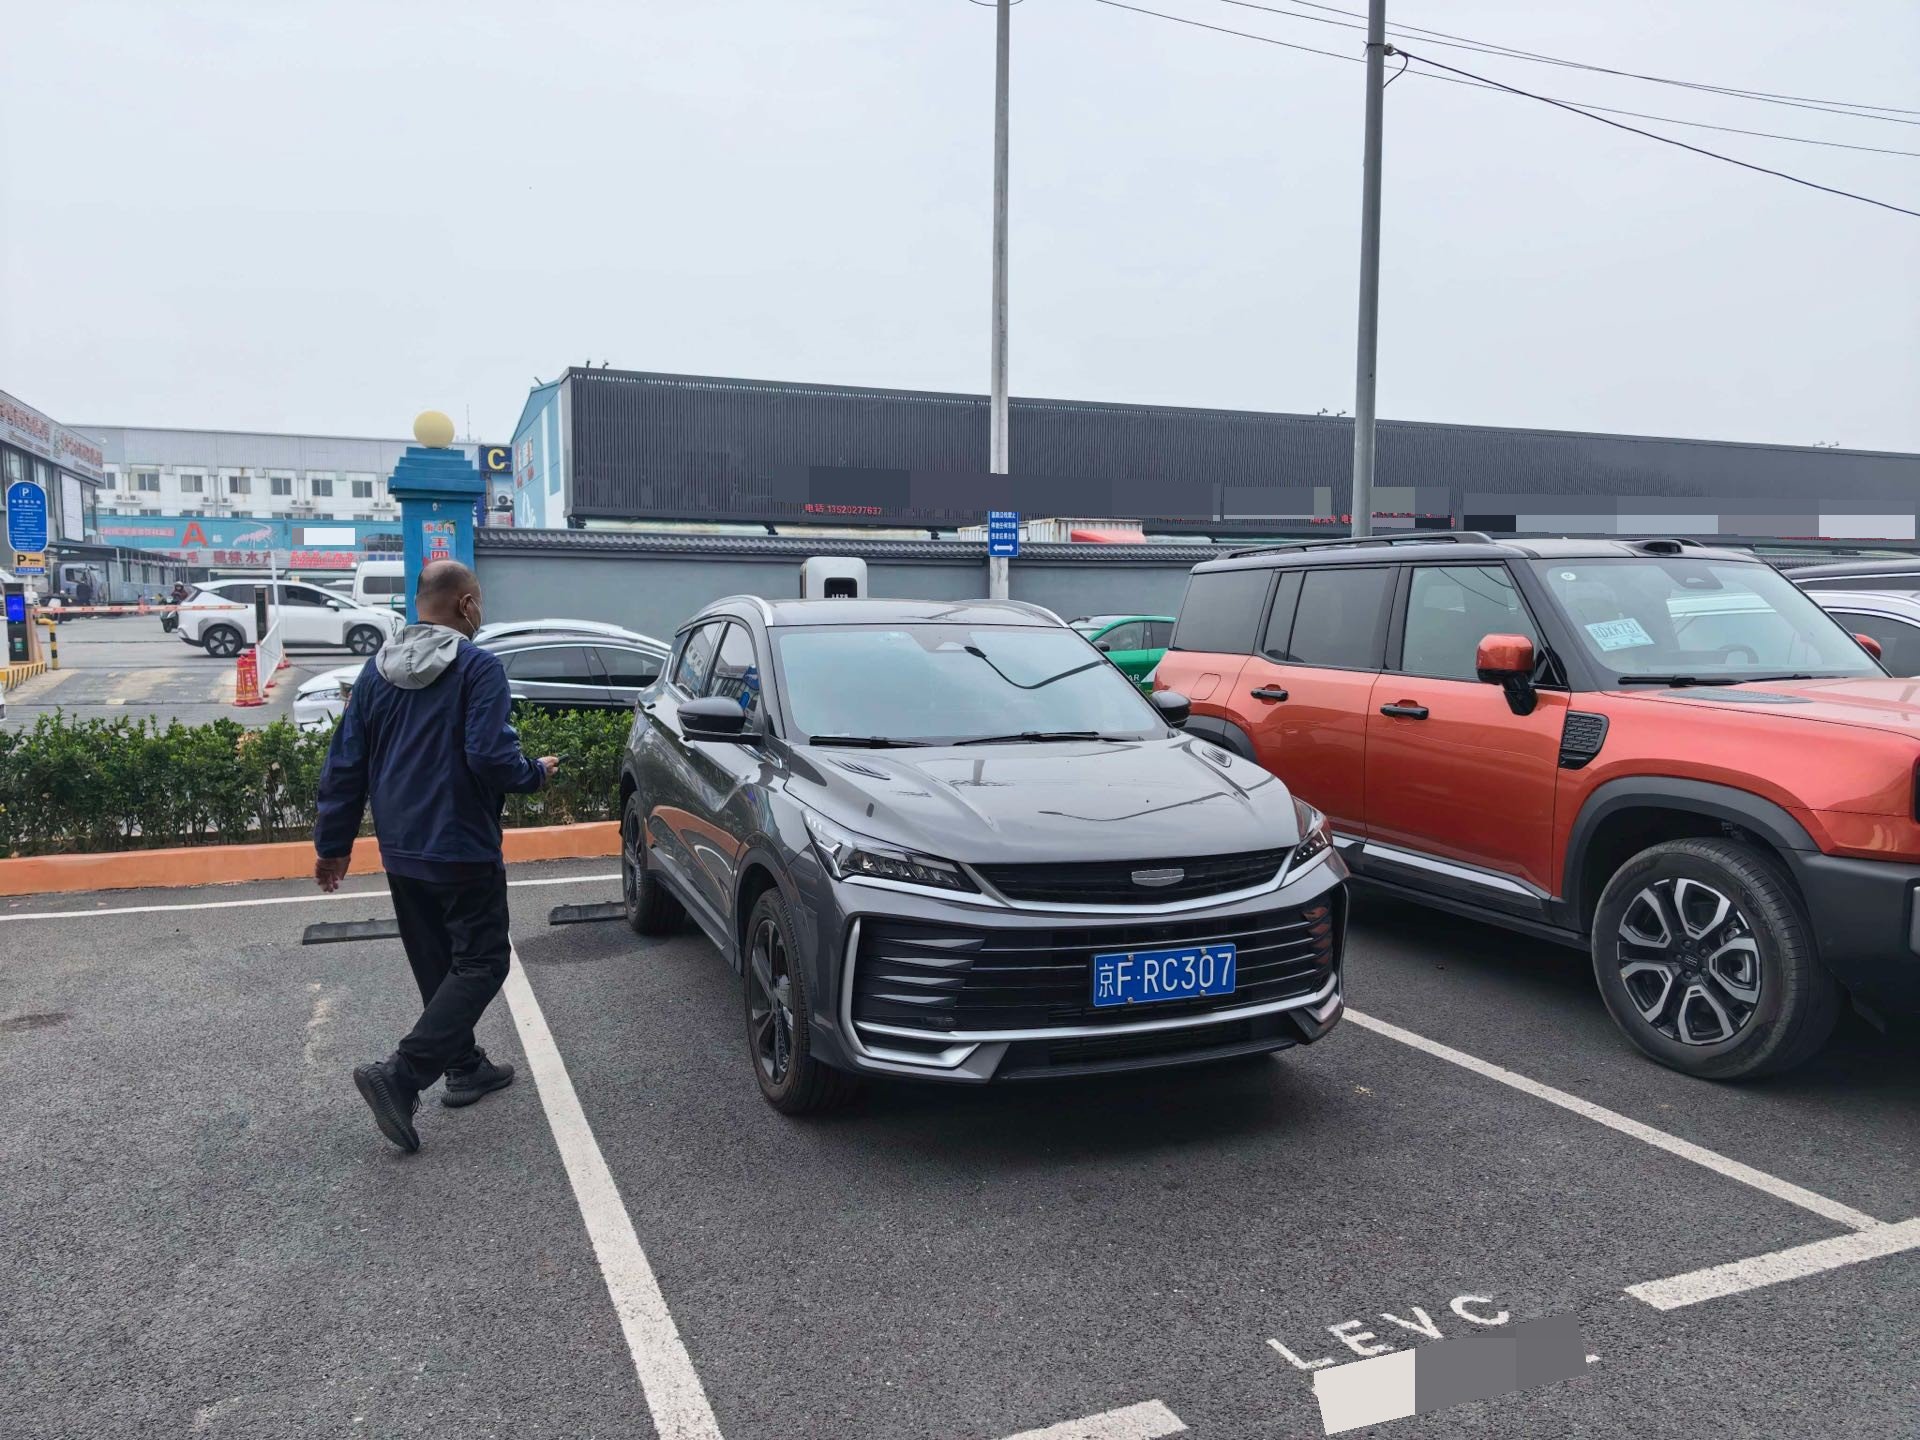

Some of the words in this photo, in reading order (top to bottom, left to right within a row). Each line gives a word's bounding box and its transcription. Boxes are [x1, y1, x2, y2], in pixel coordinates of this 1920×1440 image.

[487, 448, 506, 470] C
[181, 522, 209, 547] A
[16, 554, 27, 566] P
[1266, 1294, 1510, 1371] LEVC
